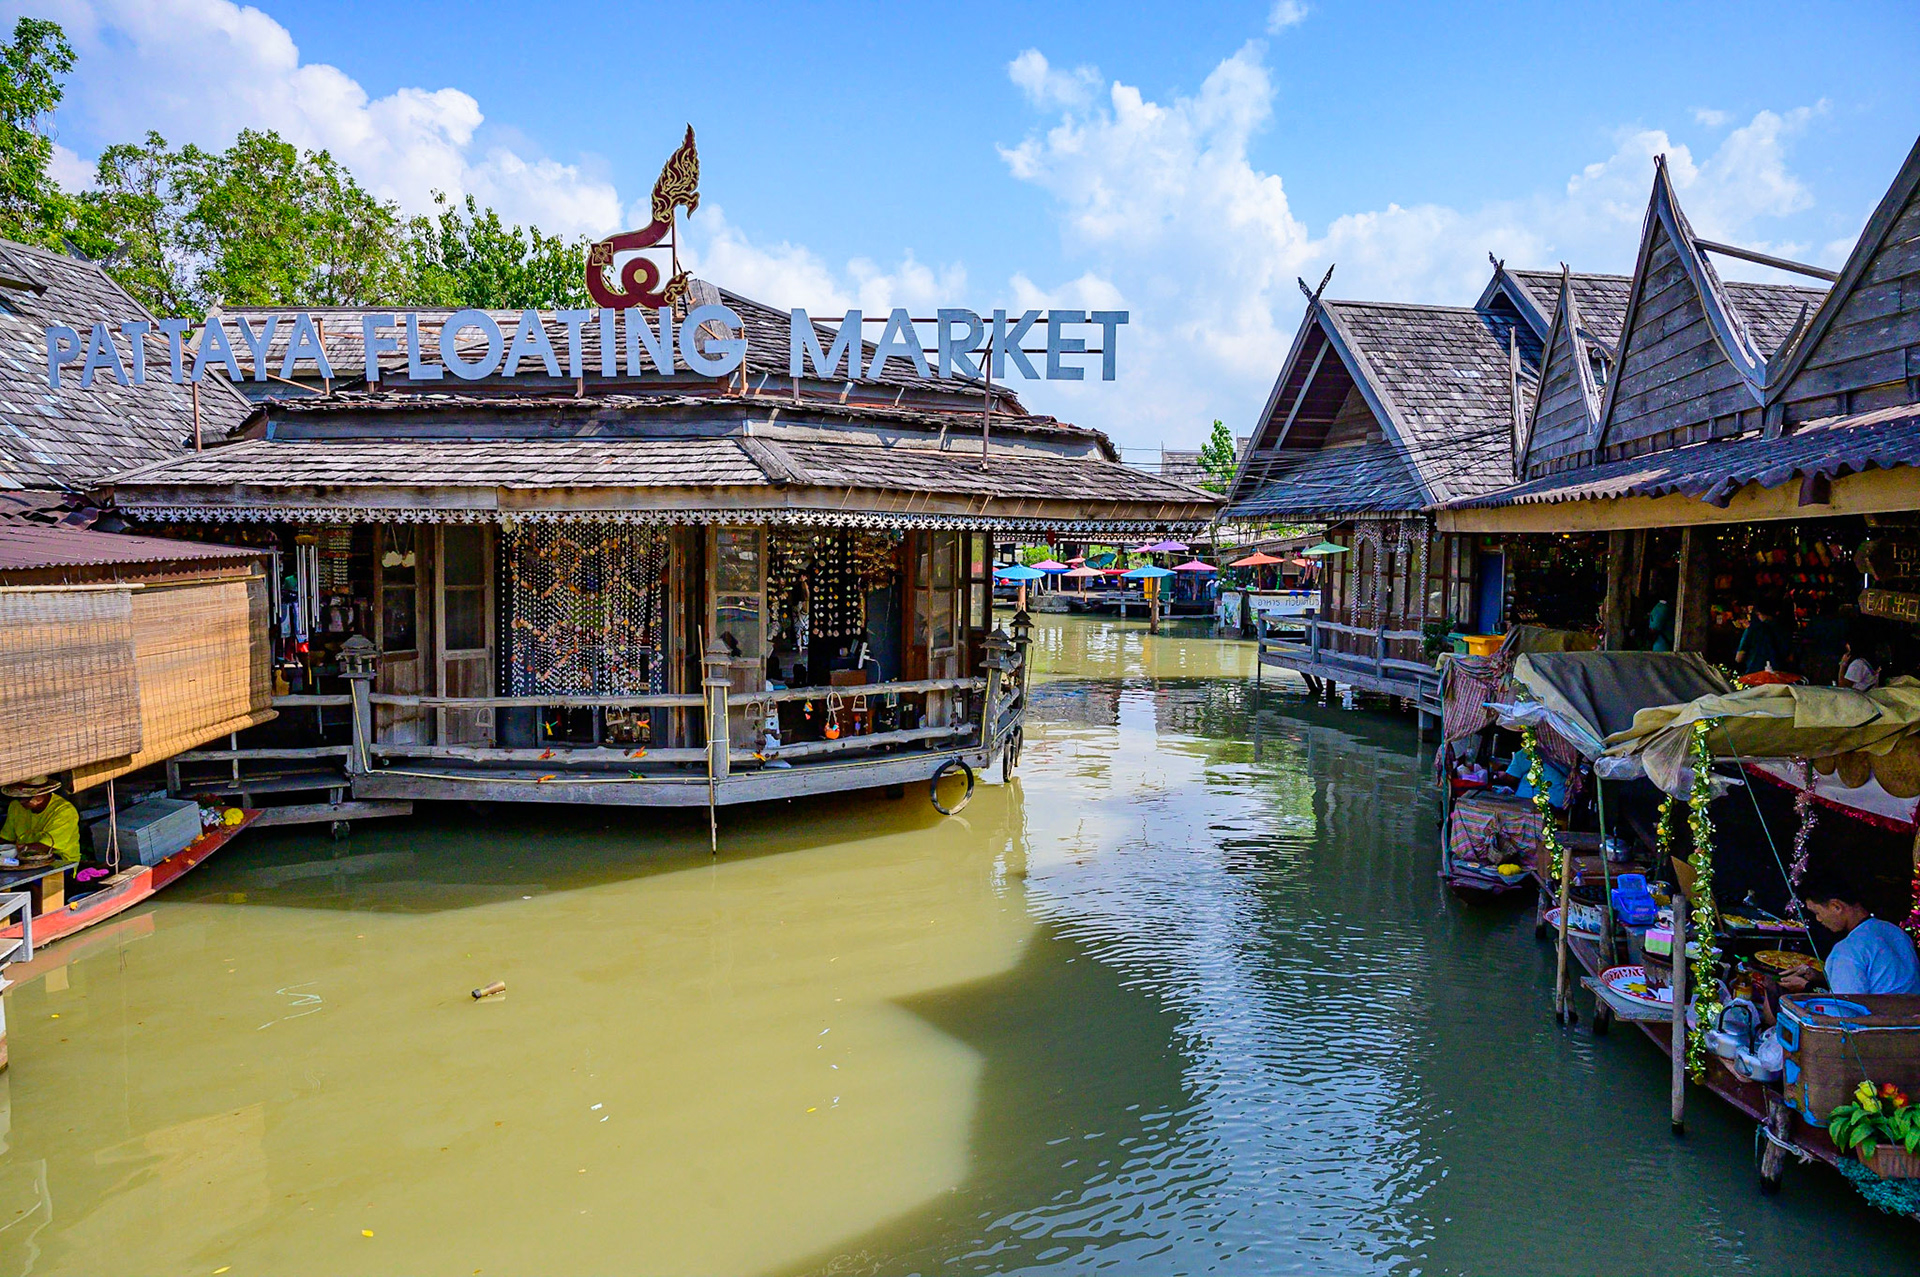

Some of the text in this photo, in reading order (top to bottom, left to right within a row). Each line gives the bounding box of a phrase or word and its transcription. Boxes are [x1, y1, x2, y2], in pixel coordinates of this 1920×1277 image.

[45, 305, 1129, 388] PATTAYA FLOATING MARKET
